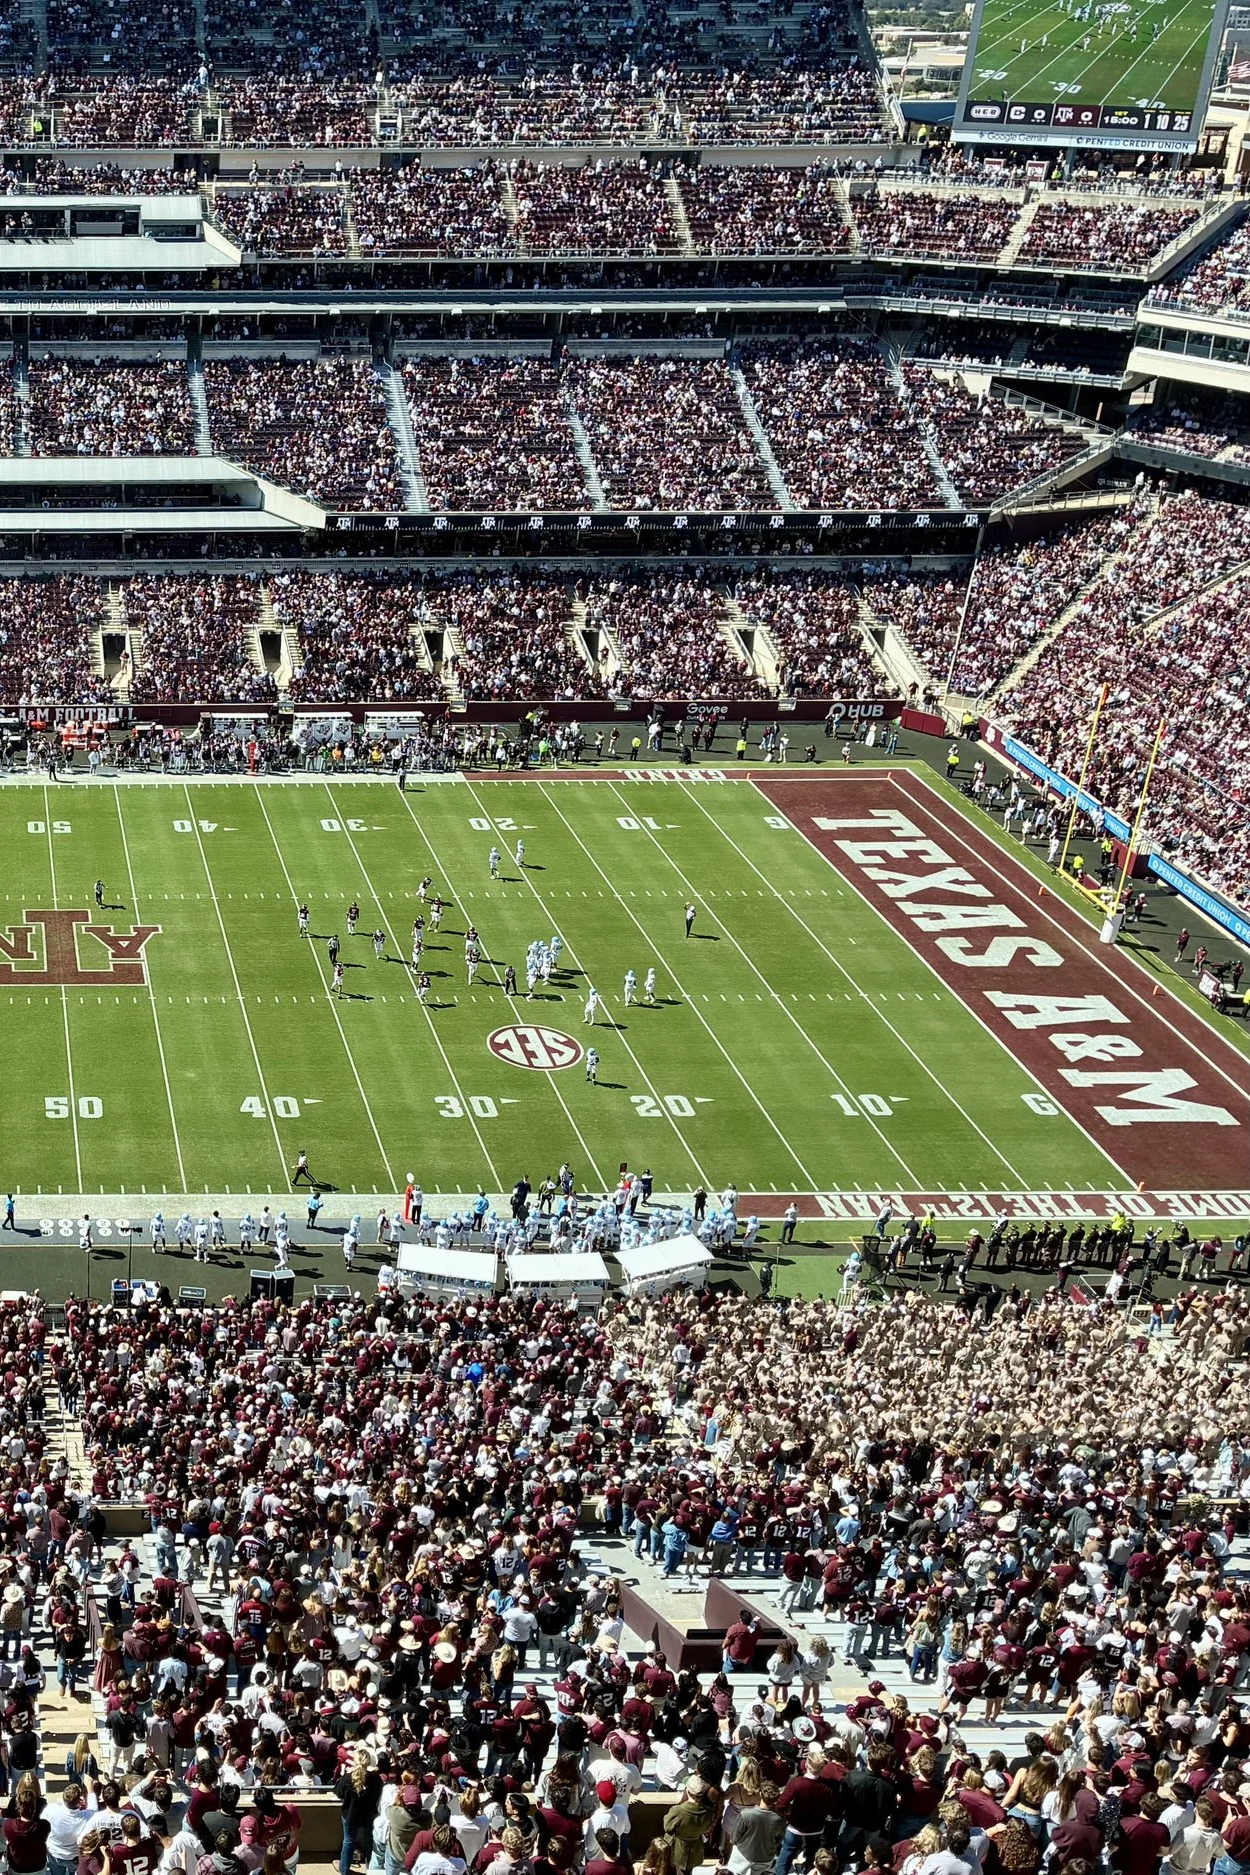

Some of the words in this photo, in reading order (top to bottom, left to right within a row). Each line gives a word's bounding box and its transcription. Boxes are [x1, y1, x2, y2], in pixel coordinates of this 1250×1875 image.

[979, 70, 1008, 80] 20
[1053, 82, 1083, 94] 30
[1033, 109, 1046, 119] 0
[1080, 111, 1093, 121] 0
[1103, 115, 1139, 125] 15:00
[1143, 115, 1150, 129] 1
[1156, 115, 1168, 130] 10
[1173, 115, 1189, 131] 25
[987, 132, 1017, 142] Google
[1018, 133, 1048, 142] Gemini
[1085, 138, 1121, 146] PENFED
[1122, 140, 1156, 148] CREDIT
[1157, 141, 1189, 150] UNION
[14, 300, 42, 310] TO
[50, 300, 171, 310] AGGIELAND
[19, 708, 49, 722] A&M
[55, 708, 137, 721] FOOTBALL
[687, 703, 728, 714] Govee
[848, 705, 884, 717] HUB
[27, 821, 71, 834] 50
[173, 819, 218, 832] 40
[320, 819, 366, 832] 30
[468, 818, 520, 831] 20
[615, 817, 663, 830] 10
[762, 816, 790, 829] G
[1158, 864, 1183, 887] PENFED
[1183, 884, 1208, 905] CREDIT
[1207, 904, 1231, 924] UNION
[811, 810, 1065, 968] TEXAS
[983, 990, 1241, 1126] A&M
[493, 1028, 580, 1068] SEC
[45, 1097, 103, 1120] 50
[240, 1096, 301, 1118] 40
[434, 1096, 499, 1118] 30
[629, 1095, 696, 1117] 20
[830, 1094, 893, 1116] 10
[1020, 1094, 1059, 1115] G
[816, 1195, 915, 1217] MAN
[1003, 1195, 1095, 1217] THE
[1103, 1195, 1155, 1216] OF
[951, 1504, 965, 1515] 12
[1160, 1500, 1175, 1511] 12
[1206, 1504, 1223, 1513] 232
[165, 1508, 178, 1519] 12
[745, 1526, 757, 1537] 12
[773, 1525, 788, 1537] 12
[796, 1527, 811, 1539] 12
[502, 1557, 515, 1568] 12
[838, 1566, 852, 1582] 12
[983, 1595, 996, 1606] 12
[249, 1614, 261, 1624] 15
[333, 1614, 346, 1624] 12
[854, 1611, 870, 1624] 12
[319, 1649, 333, 1660] 12
[1109, 1647, 1121, 1656] 12
[1040, 1655, 1055, 1667] 12
[480, 1709, 498, 1724] 12
[123, 1856, 149, 1875] 12
